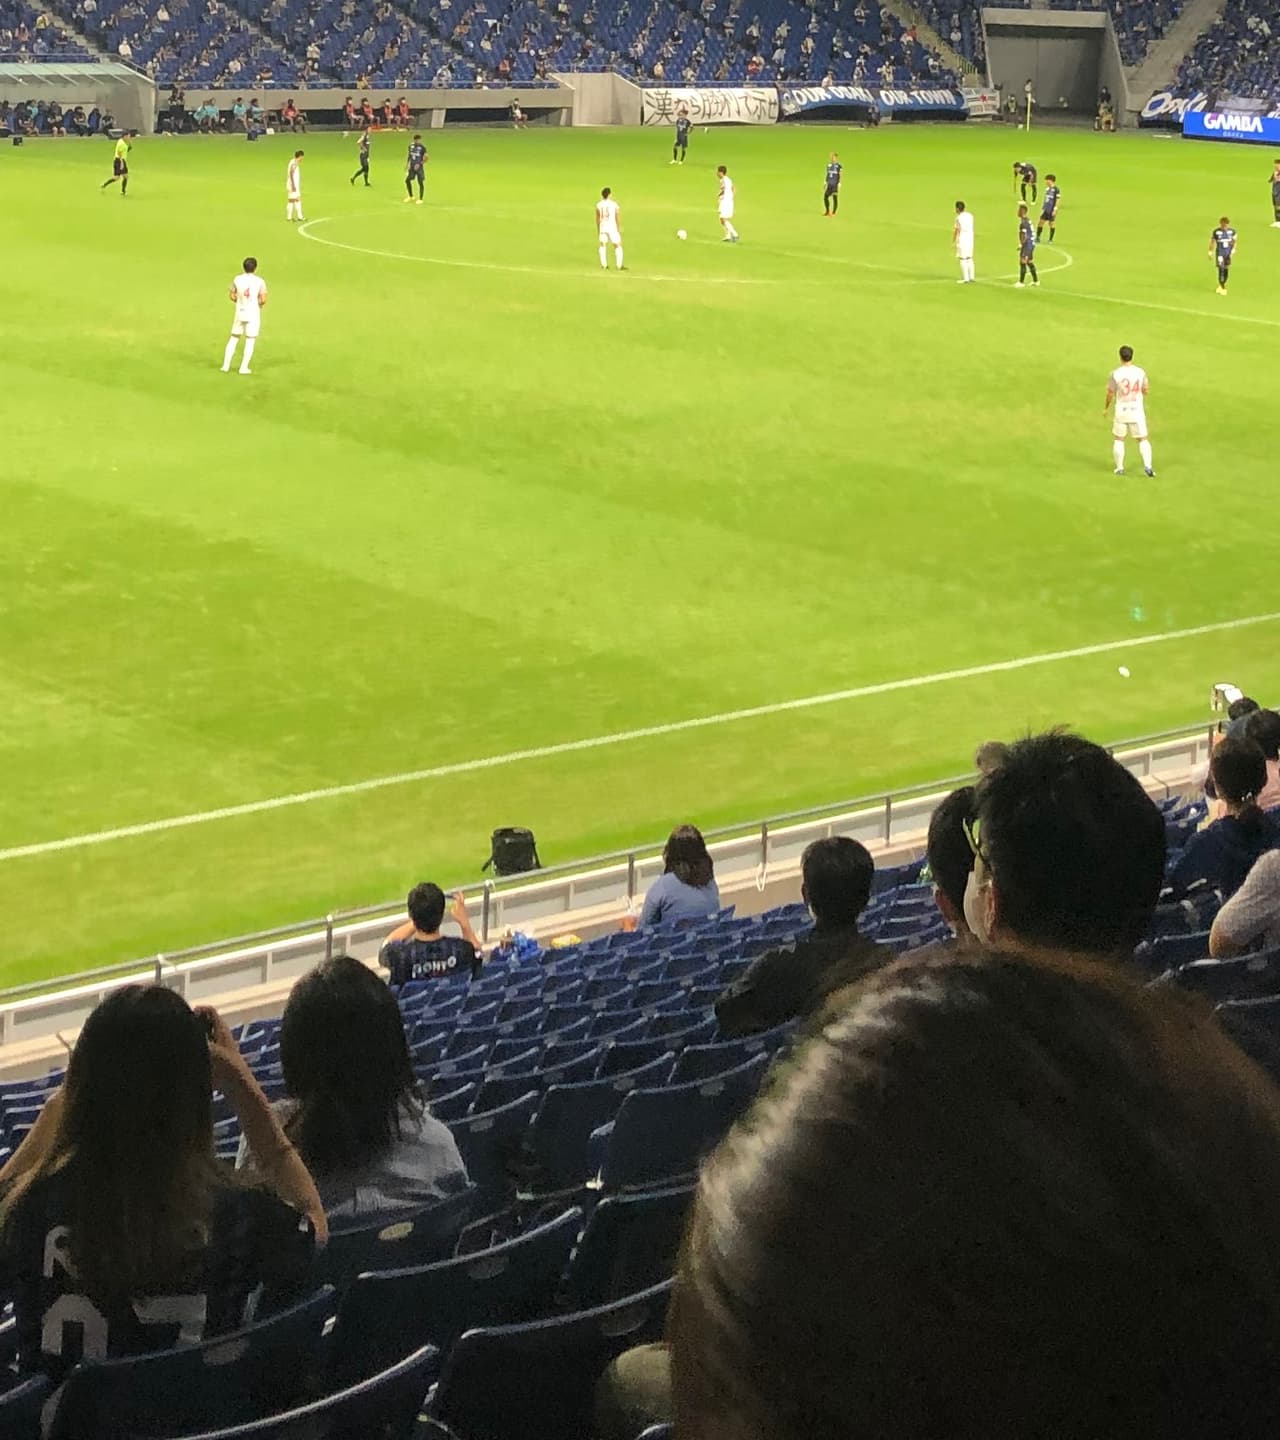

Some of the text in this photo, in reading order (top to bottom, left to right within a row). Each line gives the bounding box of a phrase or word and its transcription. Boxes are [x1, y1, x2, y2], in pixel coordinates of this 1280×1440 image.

[791, 86, 831, 106] OUR
[878, 89, 912, 106] OUR
[910, 89, 957, 106] TOWN
[1203, 111, 1264, 134] GAMBA
[1120, 378, 1140, 396] 34
[411, 955, 458, 979] ROHTO
